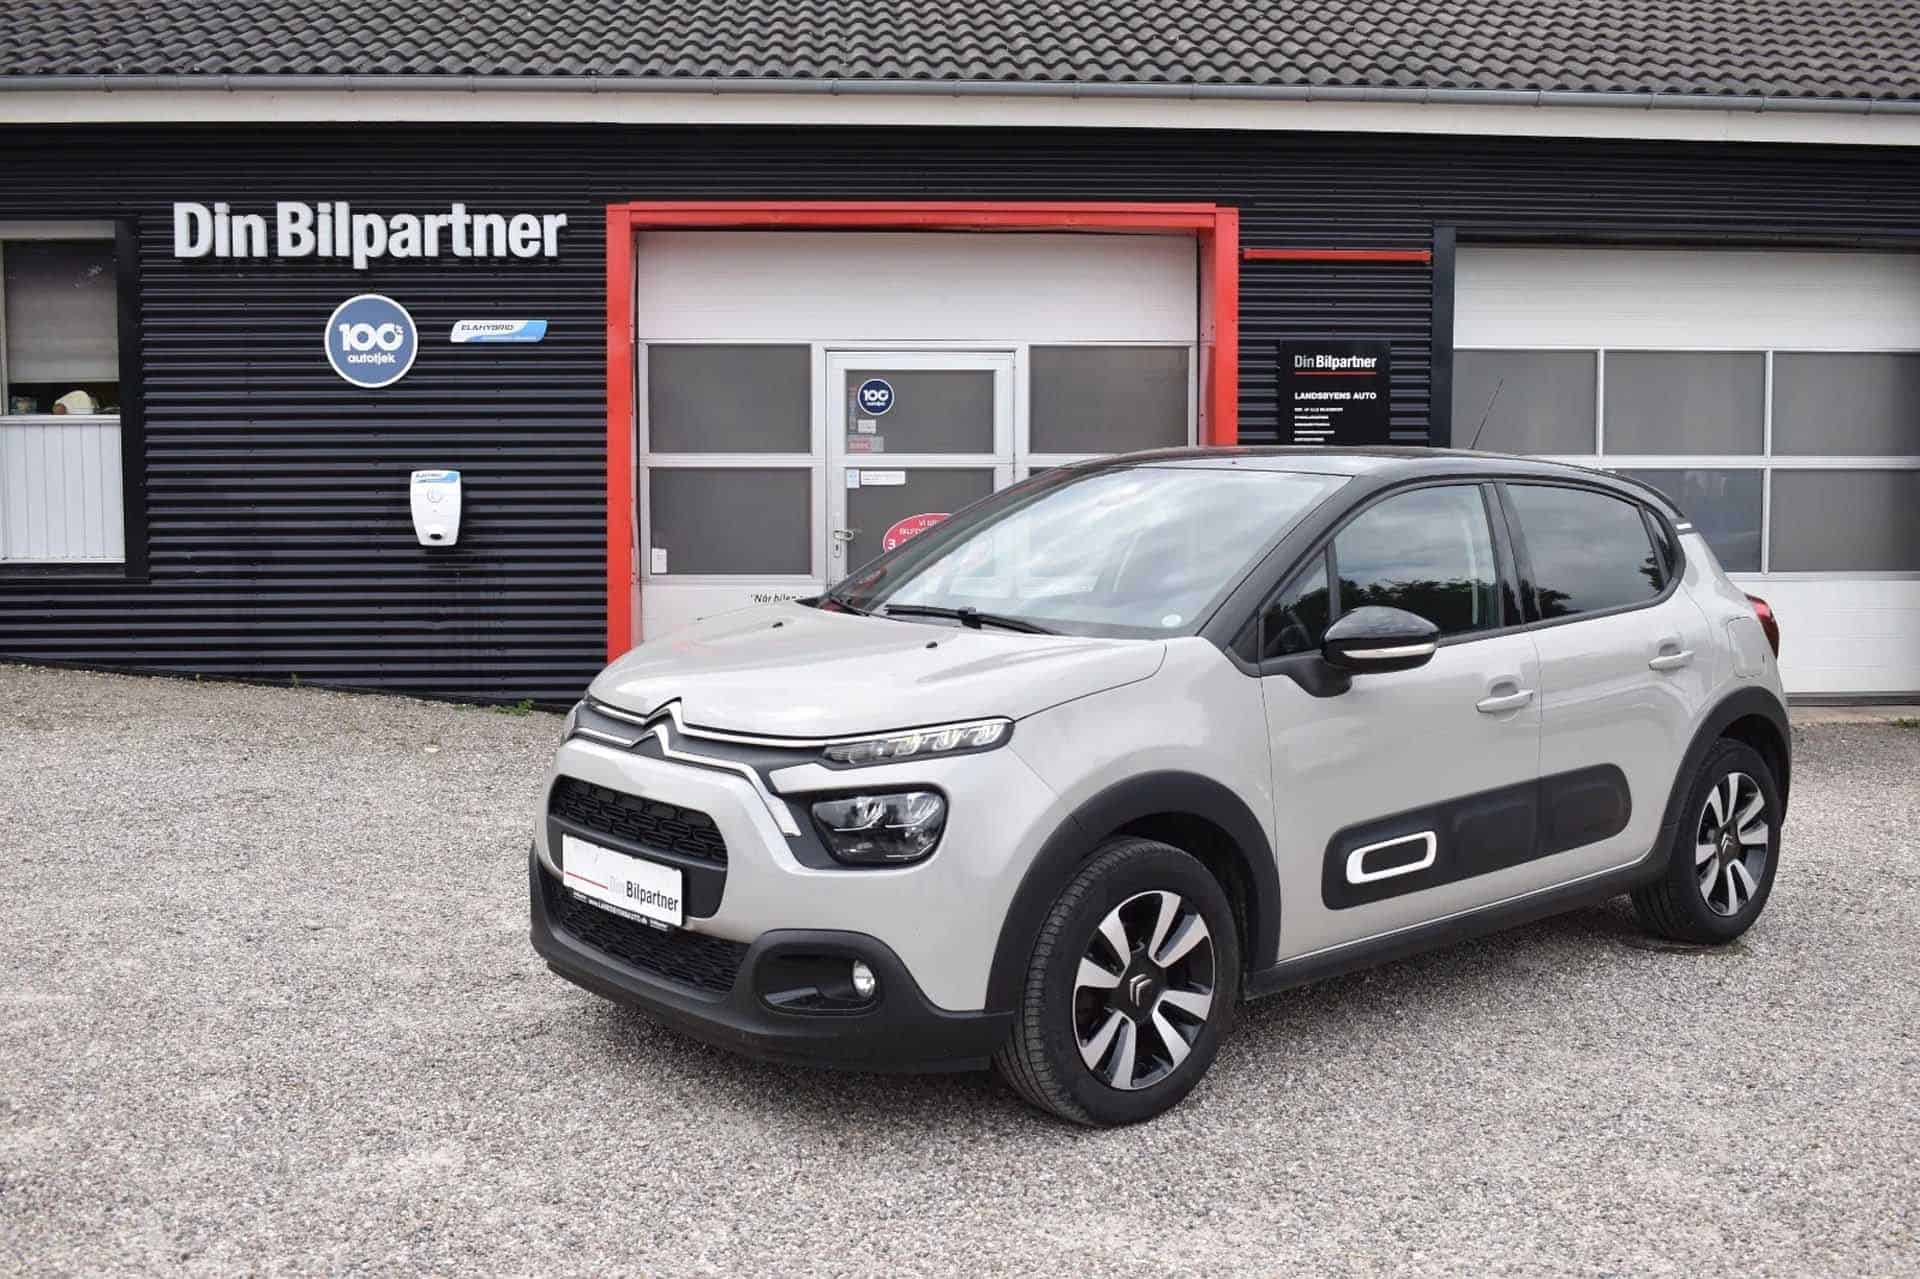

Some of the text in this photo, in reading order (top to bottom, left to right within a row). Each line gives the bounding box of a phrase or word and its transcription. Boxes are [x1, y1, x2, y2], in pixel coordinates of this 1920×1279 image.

[173, 201, 568, 270] Din Bilpartner
[347, 352, 396, 366] autotjek
[1294, 355, 1377, 371] Din Bilpartner
[1294, 391, 1377, 400] LANDSBYENS AUTO
[626, 880, 679, 912] Bilpartner
